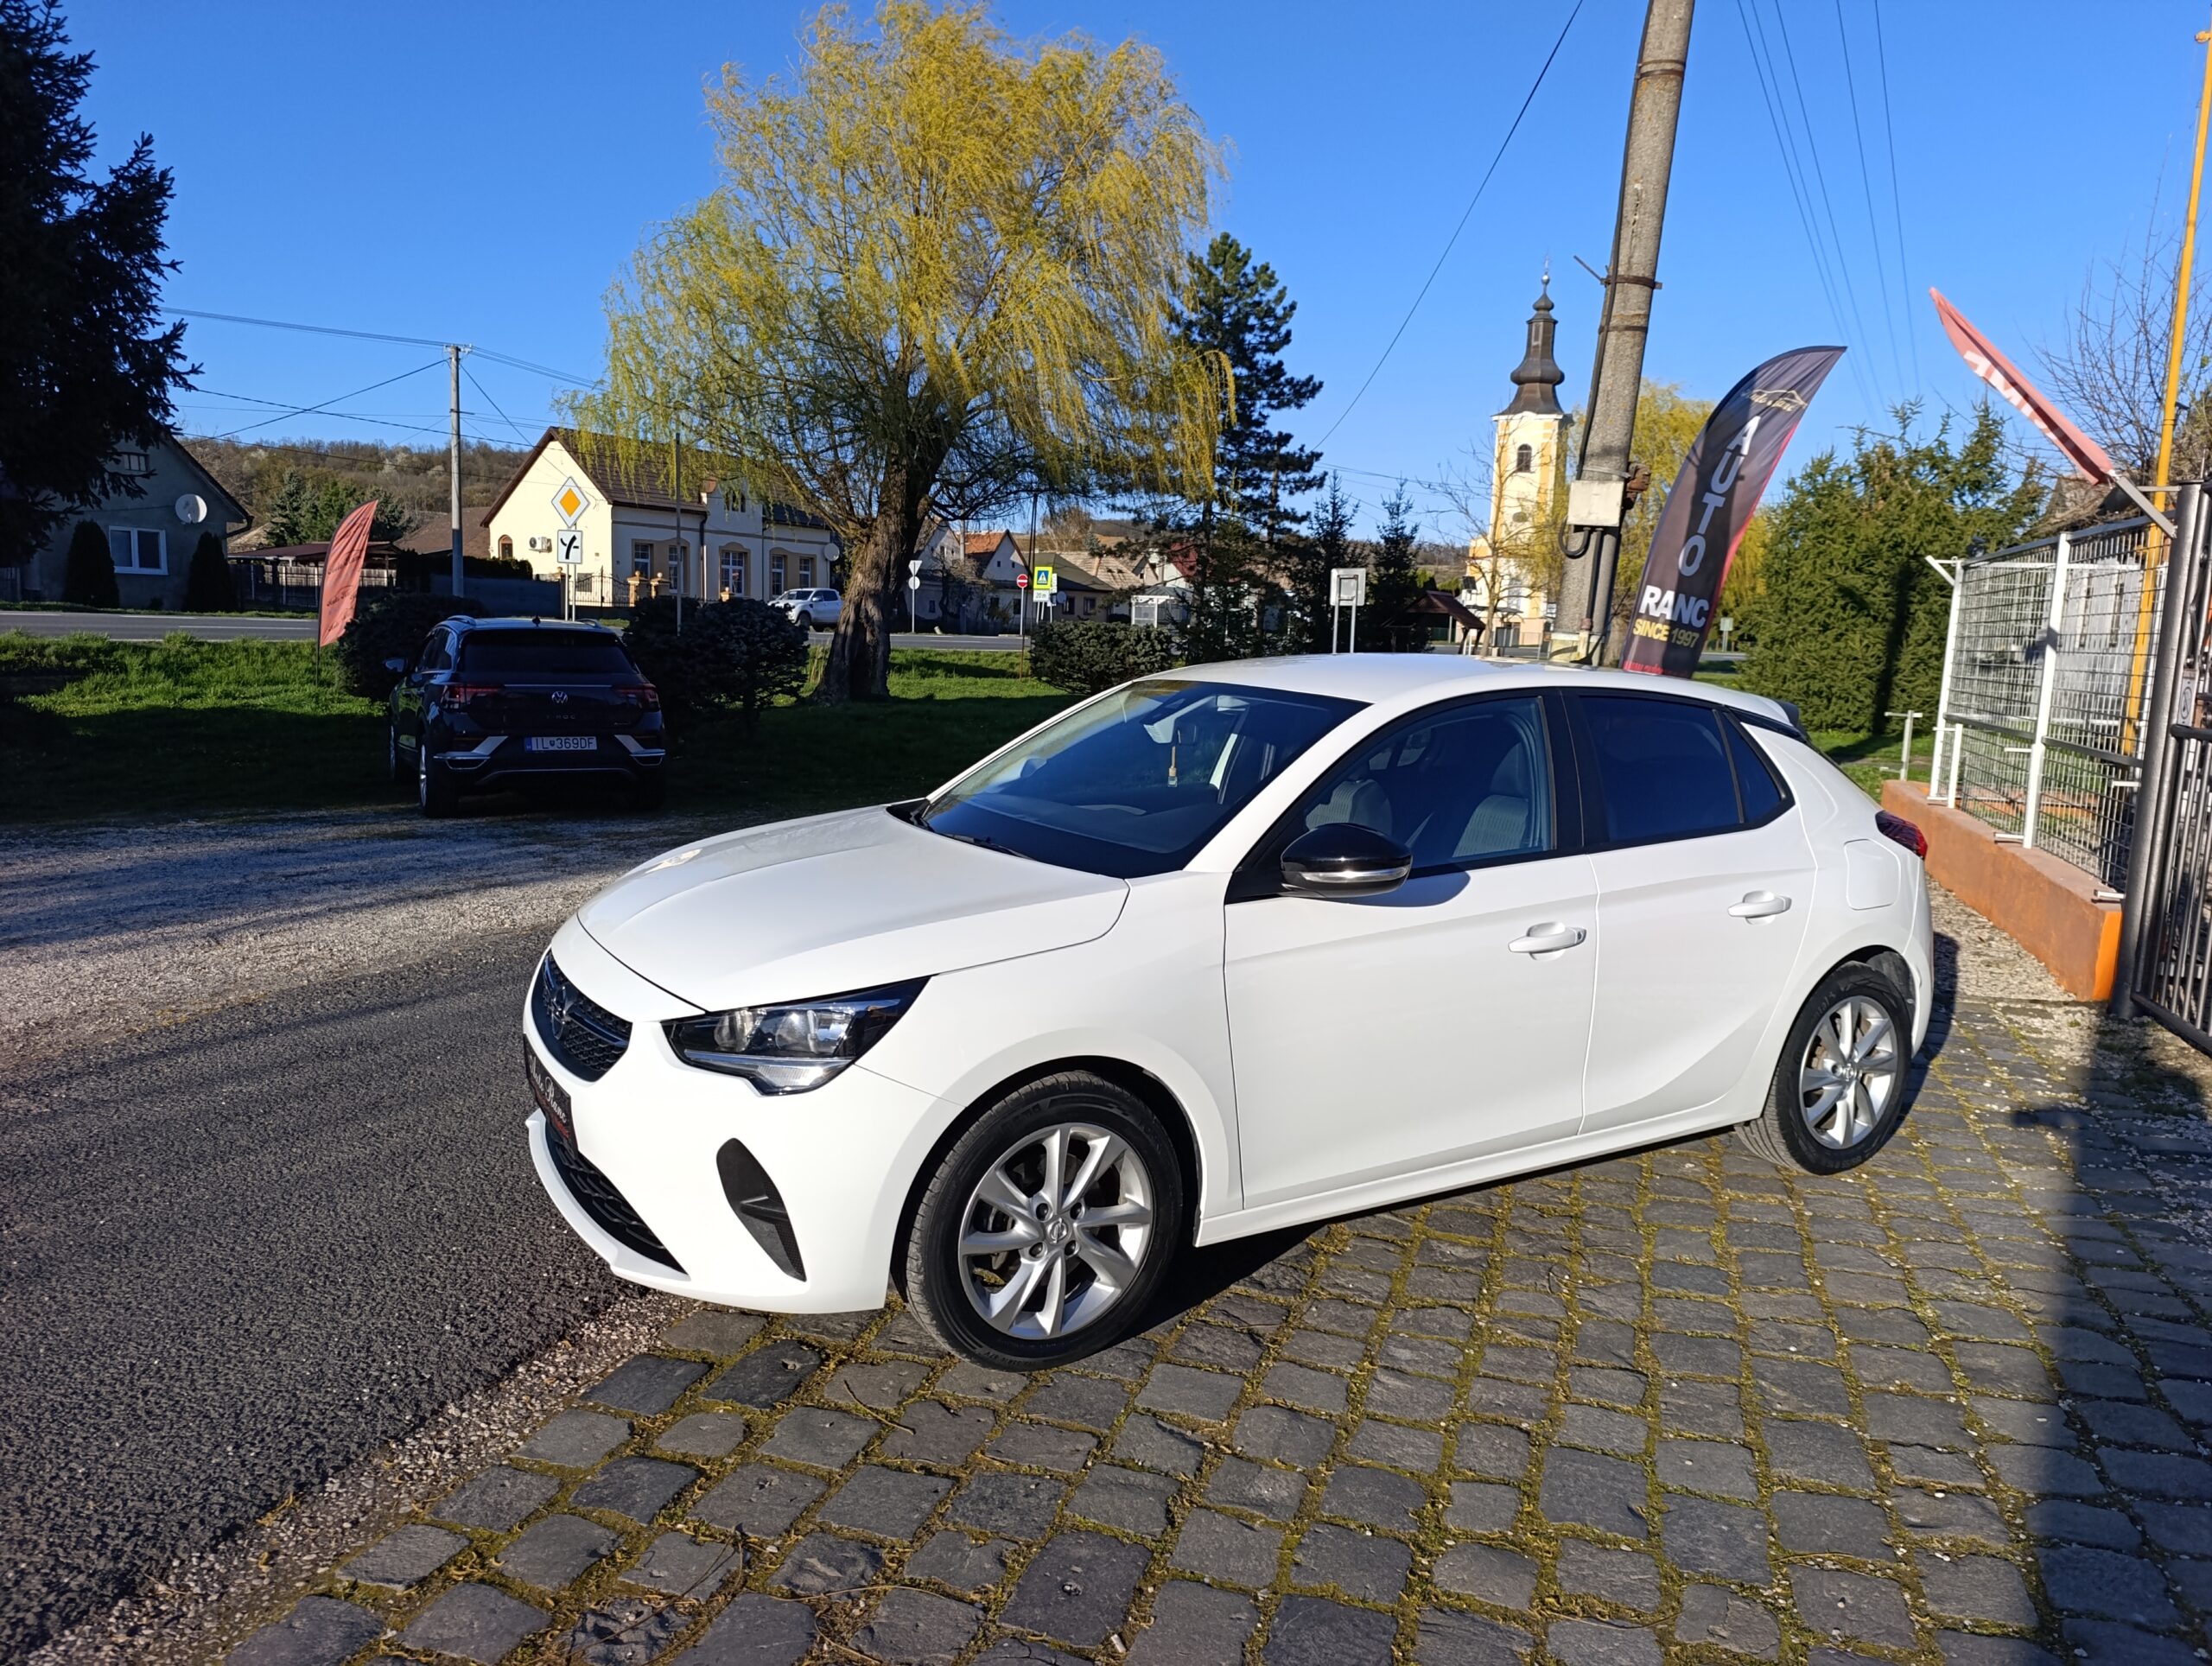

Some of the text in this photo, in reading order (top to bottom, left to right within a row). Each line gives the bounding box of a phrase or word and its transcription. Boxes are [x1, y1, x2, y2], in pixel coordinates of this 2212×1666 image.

[1678, 415, 1762, 577] AUTO
[1638, 584, 1709, 628] RANC
[1632, 618, 1700, 649] SINCE 1997
